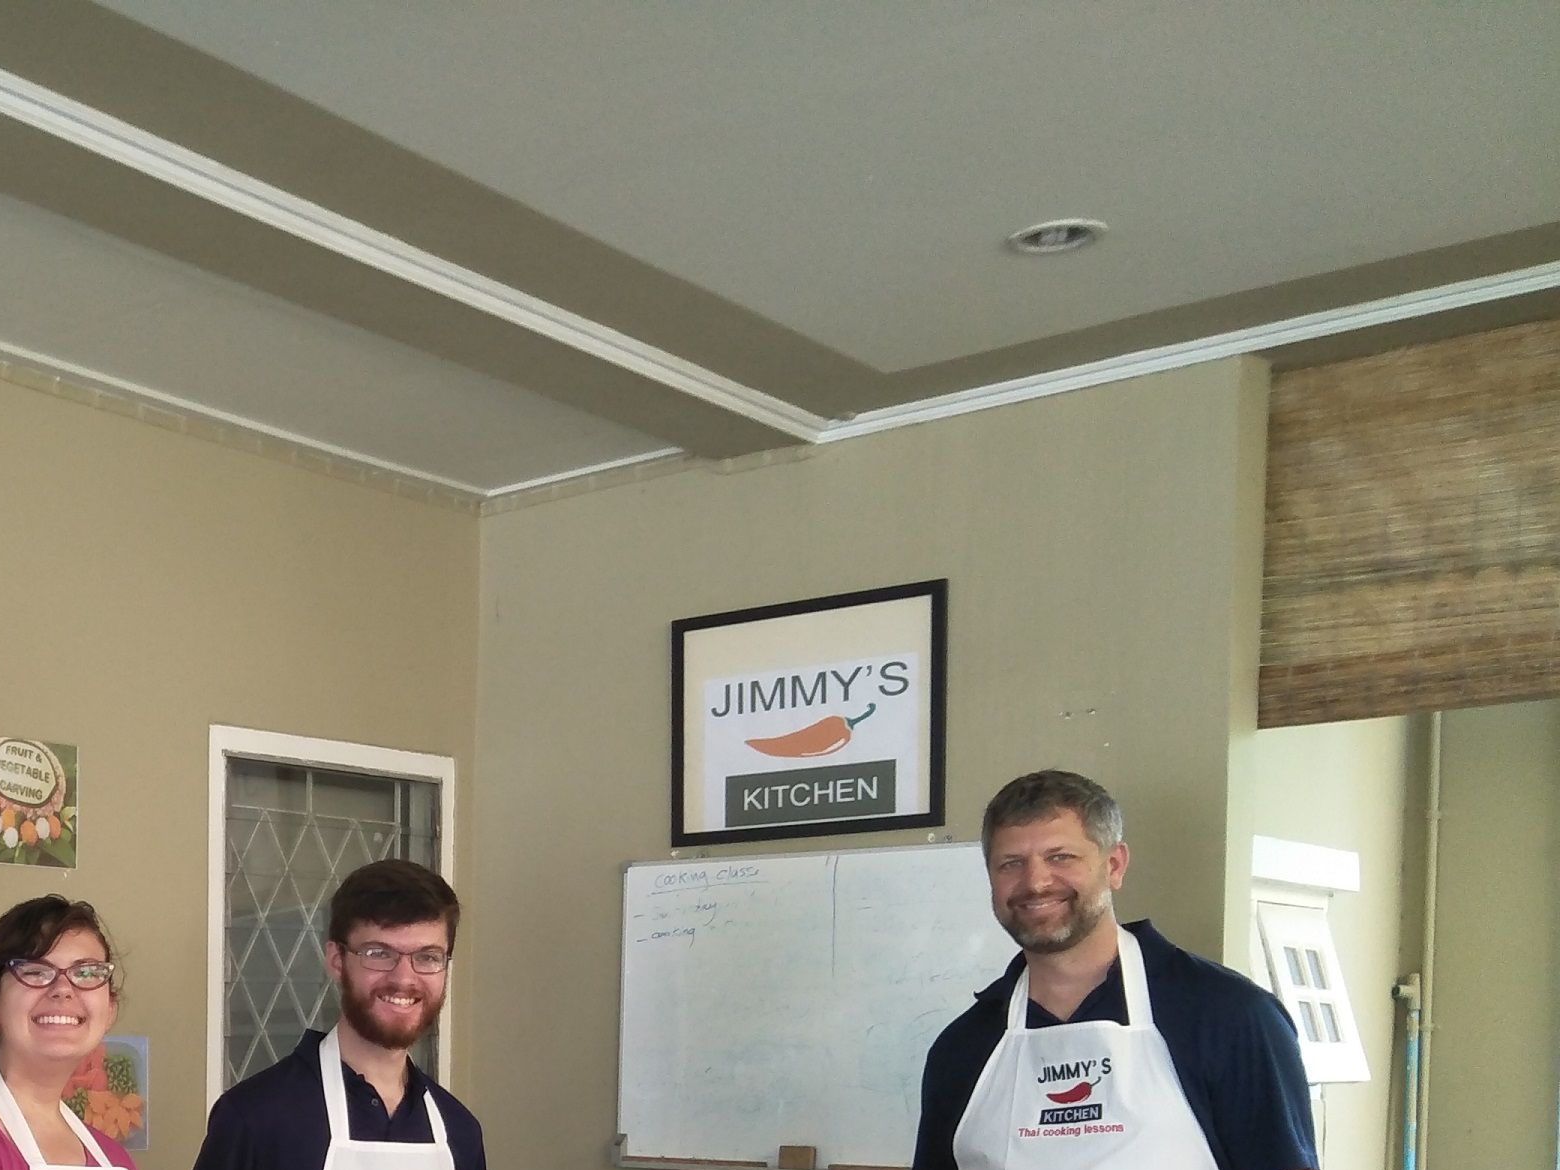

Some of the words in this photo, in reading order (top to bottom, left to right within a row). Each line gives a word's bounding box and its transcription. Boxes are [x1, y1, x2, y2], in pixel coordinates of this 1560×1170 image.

[710, 660, 910, 718] JIMMY'S
[5, 745, 34, 761] FRUIT
[35, 753, 43, 764] &
[0, 779, 44, 800] CARVING
[742, 775, 879, 812] KITCHEN
[1037, 1057, 1113, 1084] JIMMY'S
[1042, 1106, 1100, 1123] KITCHEN
[1018, 1128, 1040, 1137] Thai
[1042, 1126, 1081, 1137] cooking
[1083, 1123, 1125, 1134] lessons
